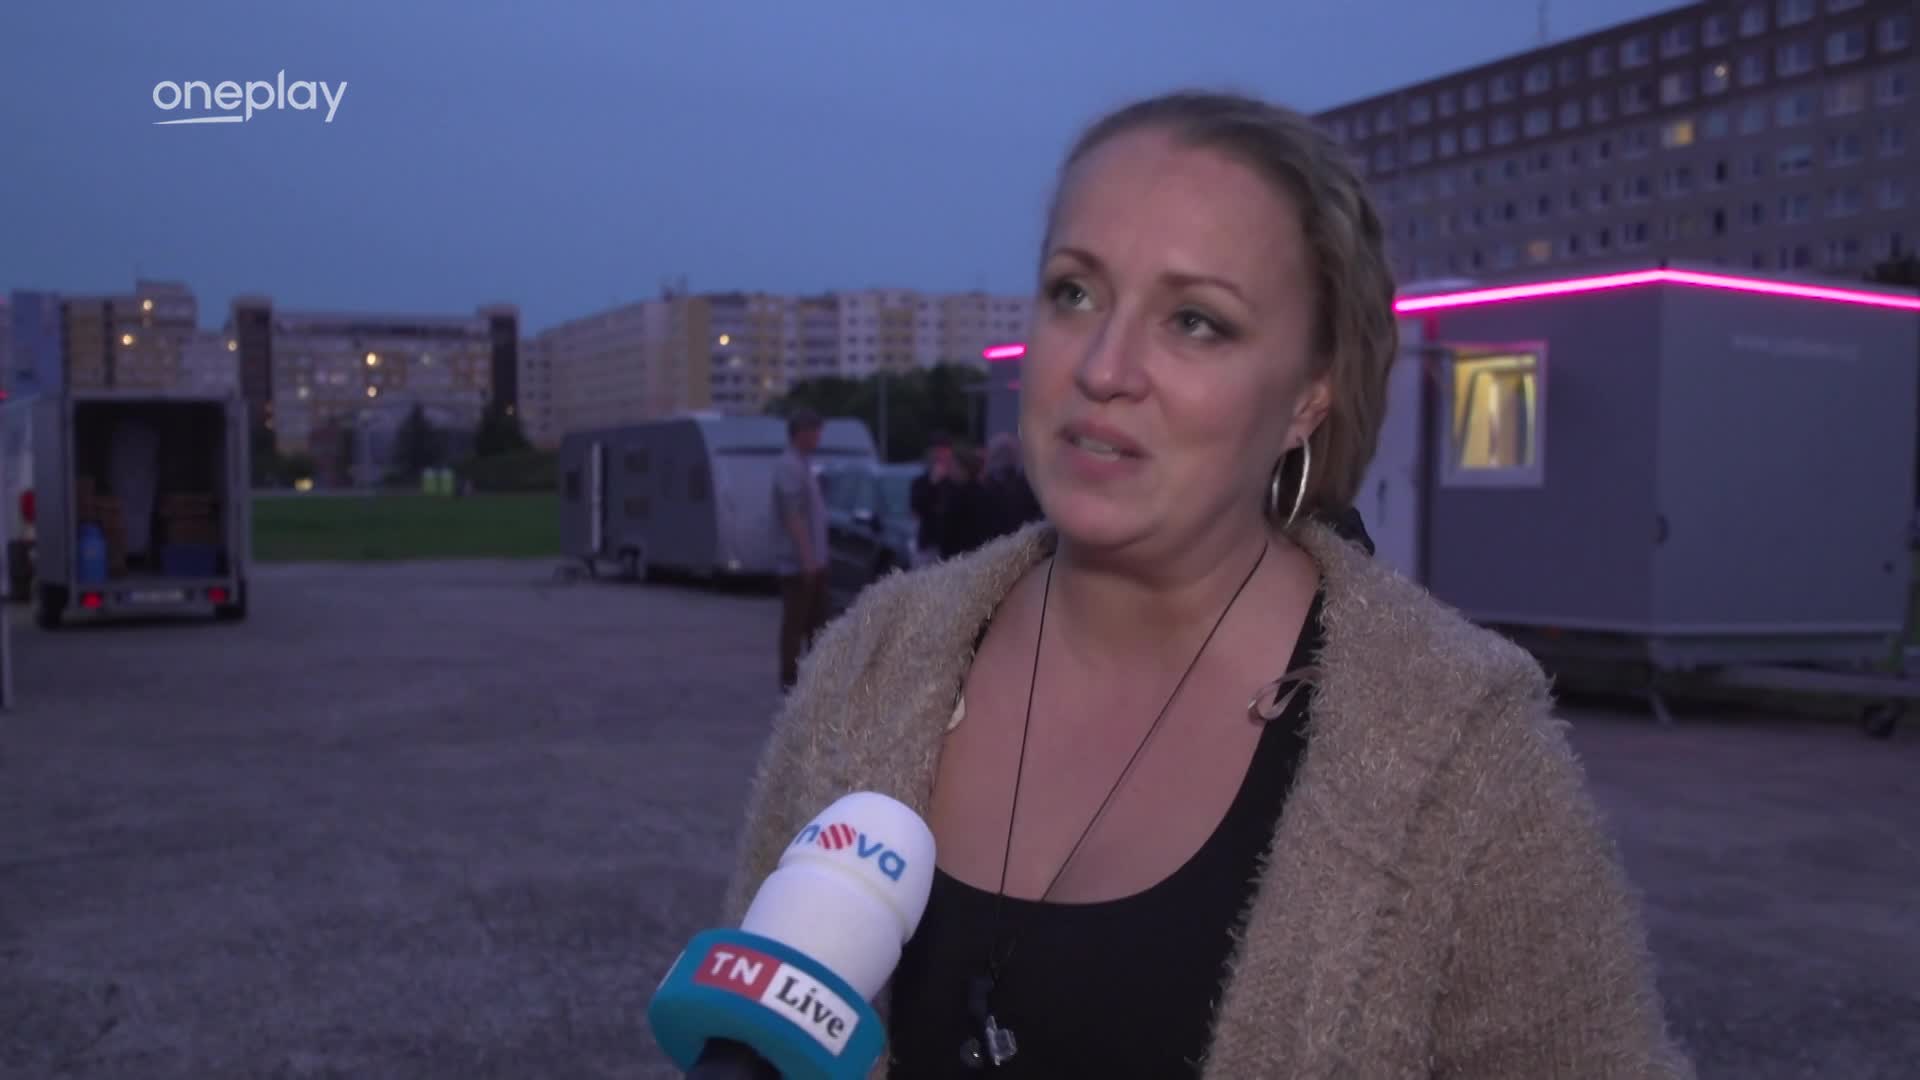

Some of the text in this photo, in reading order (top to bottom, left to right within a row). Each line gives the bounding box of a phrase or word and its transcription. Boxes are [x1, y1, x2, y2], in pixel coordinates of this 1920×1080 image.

[795, 824, 906, 881] nova
[710, 951, 845, 1038] TN Live
